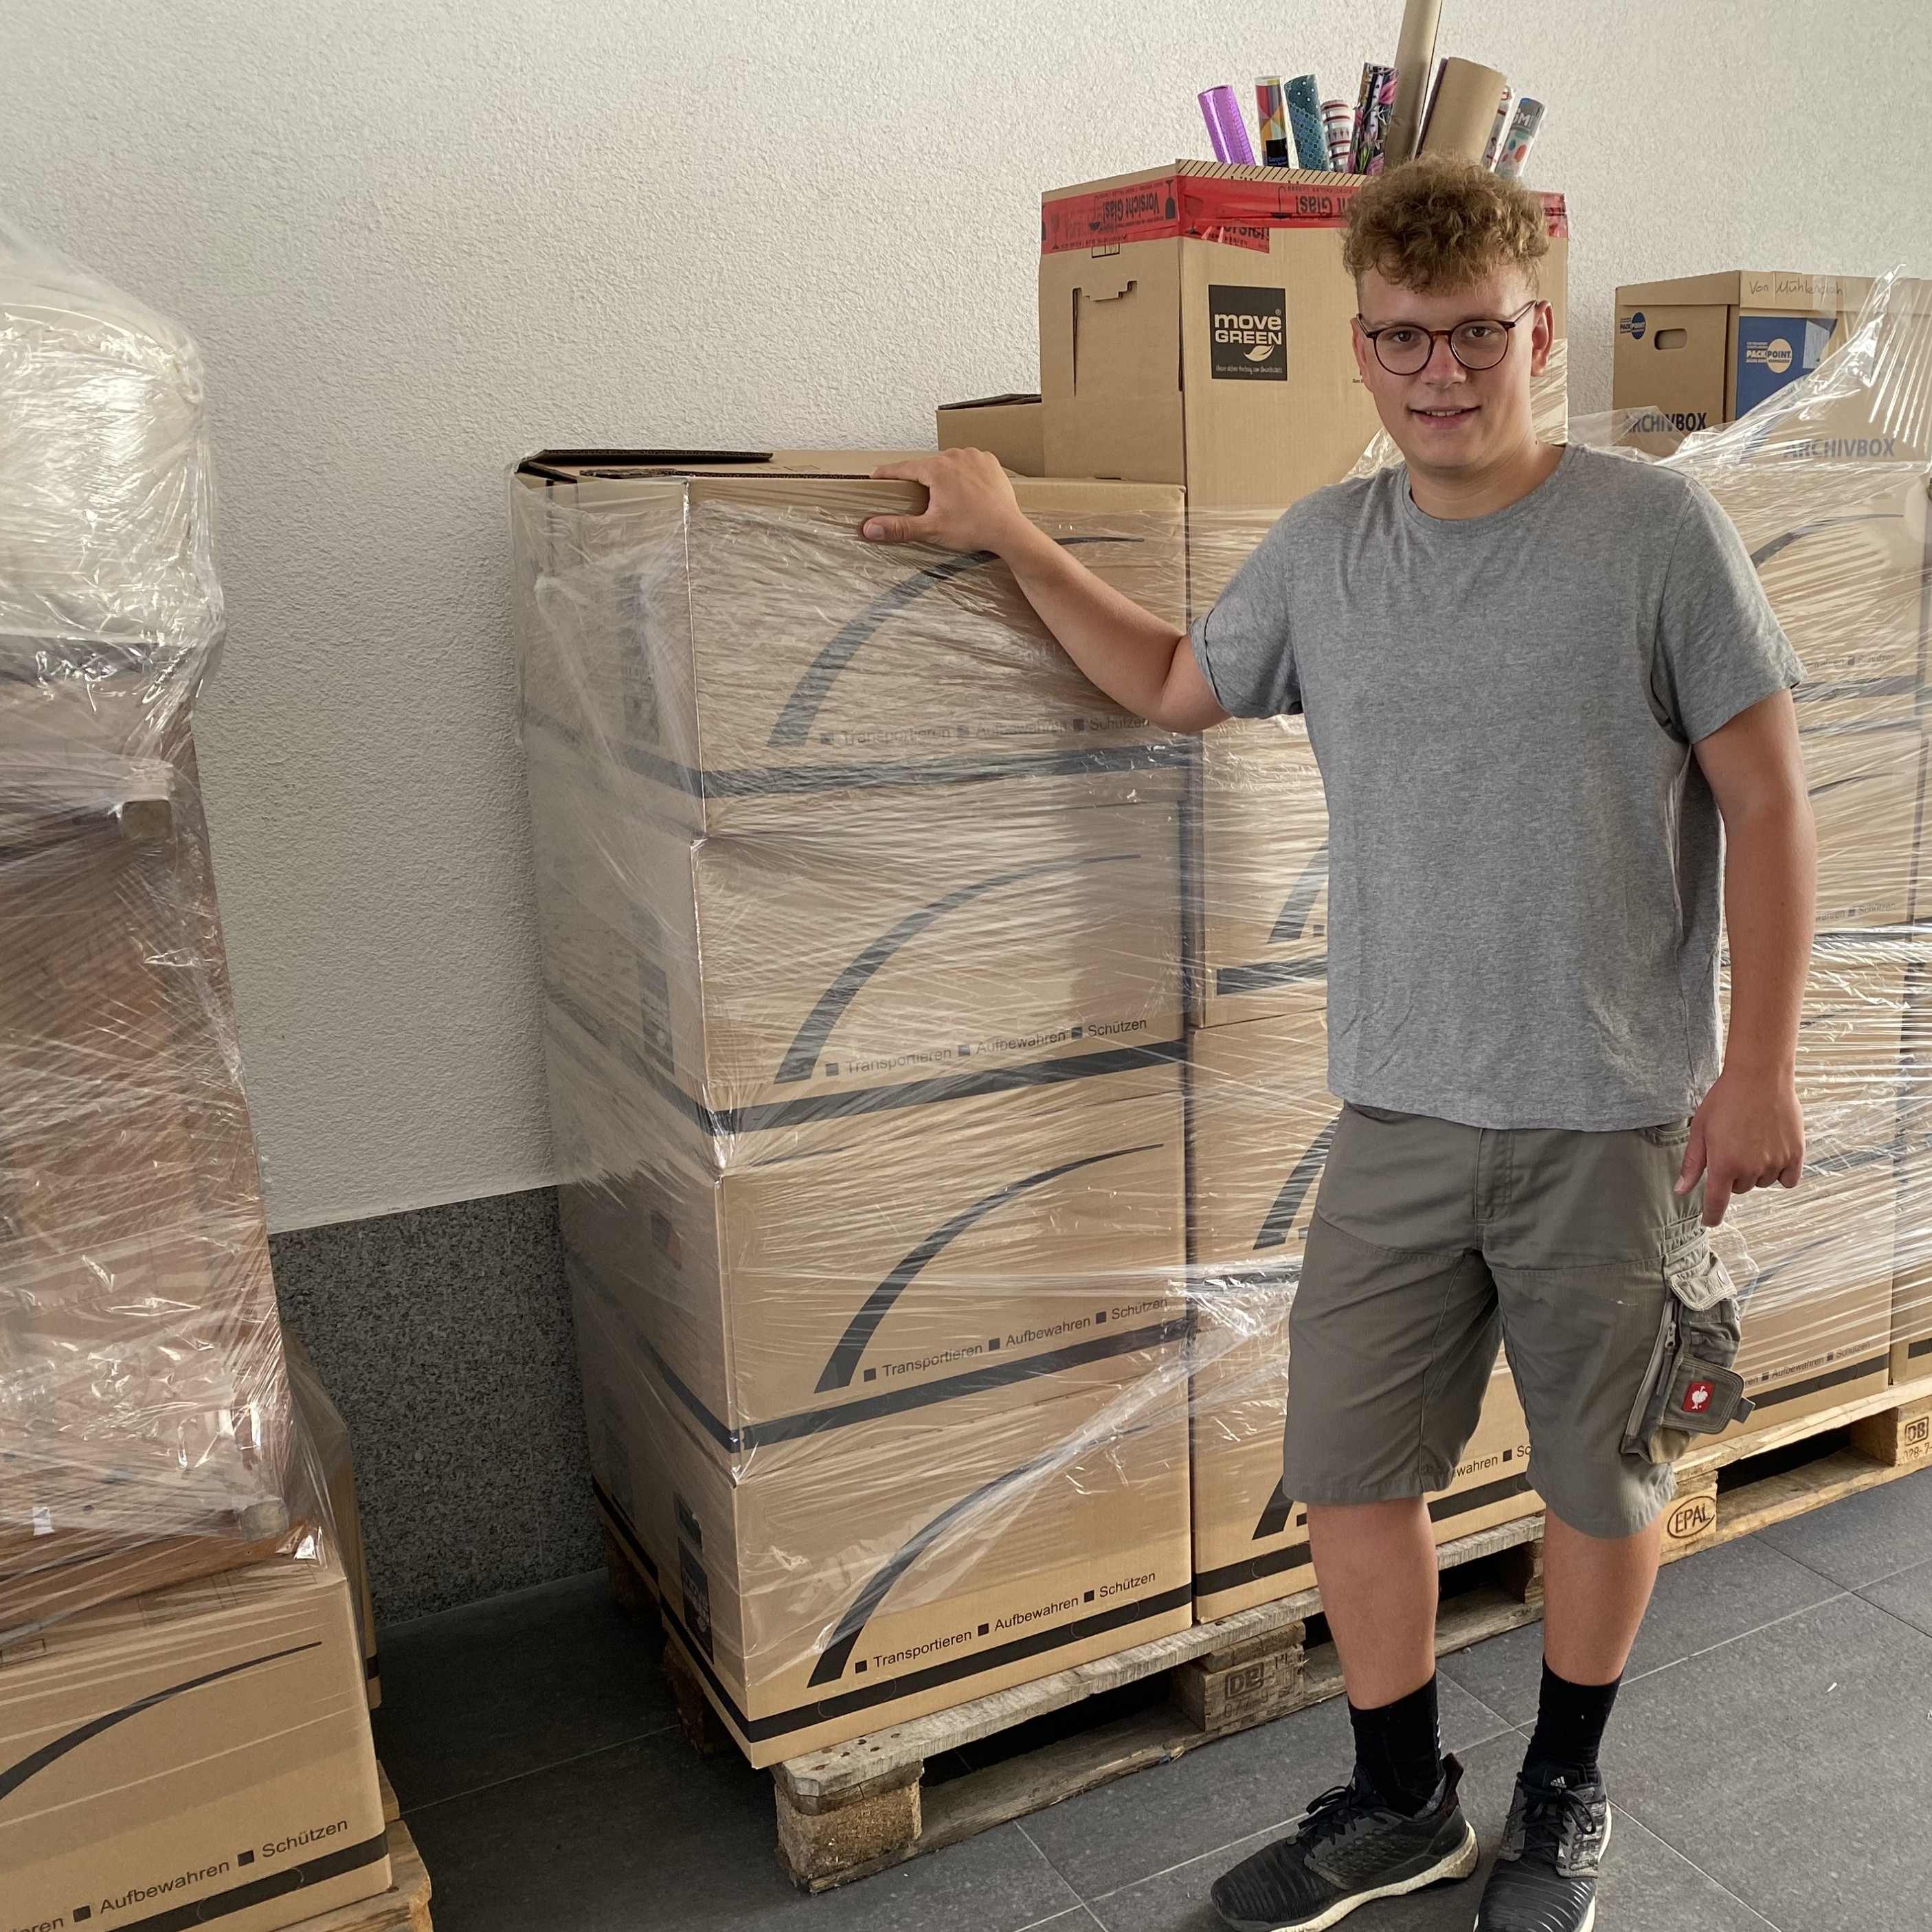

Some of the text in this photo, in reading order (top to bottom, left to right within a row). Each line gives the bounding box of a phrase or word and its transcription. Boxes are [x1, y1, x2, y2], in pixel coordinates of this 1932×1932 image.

[1102, 192, 1160, 223] Vorsicht Glas!
[1295, 194, 1333, 216] Glas!
[1749, 280, 1769, 295] Von
[1214, 314, 1282, 330] move
[1215, 330, 1282, 345] GREEN
[841, 726, 951, 746] Transportieren
[845, 1019, 1147, 1076] Transportieren Aufbewahren Schützen
[882, 1298, 1168, 1378] Transportieren Aufbewahren Schützen
[1771, 1356, 1824, 1379] Aufbewahren
[1675, 1503, 1711, 1534] EPAL
[873, 1572, 1156, 1669] Transportieren Aufbewahren Schützen
[99, 1860, 230, 1914] Aufbewahren
[261, 1819, 349, 1858] Schützen
